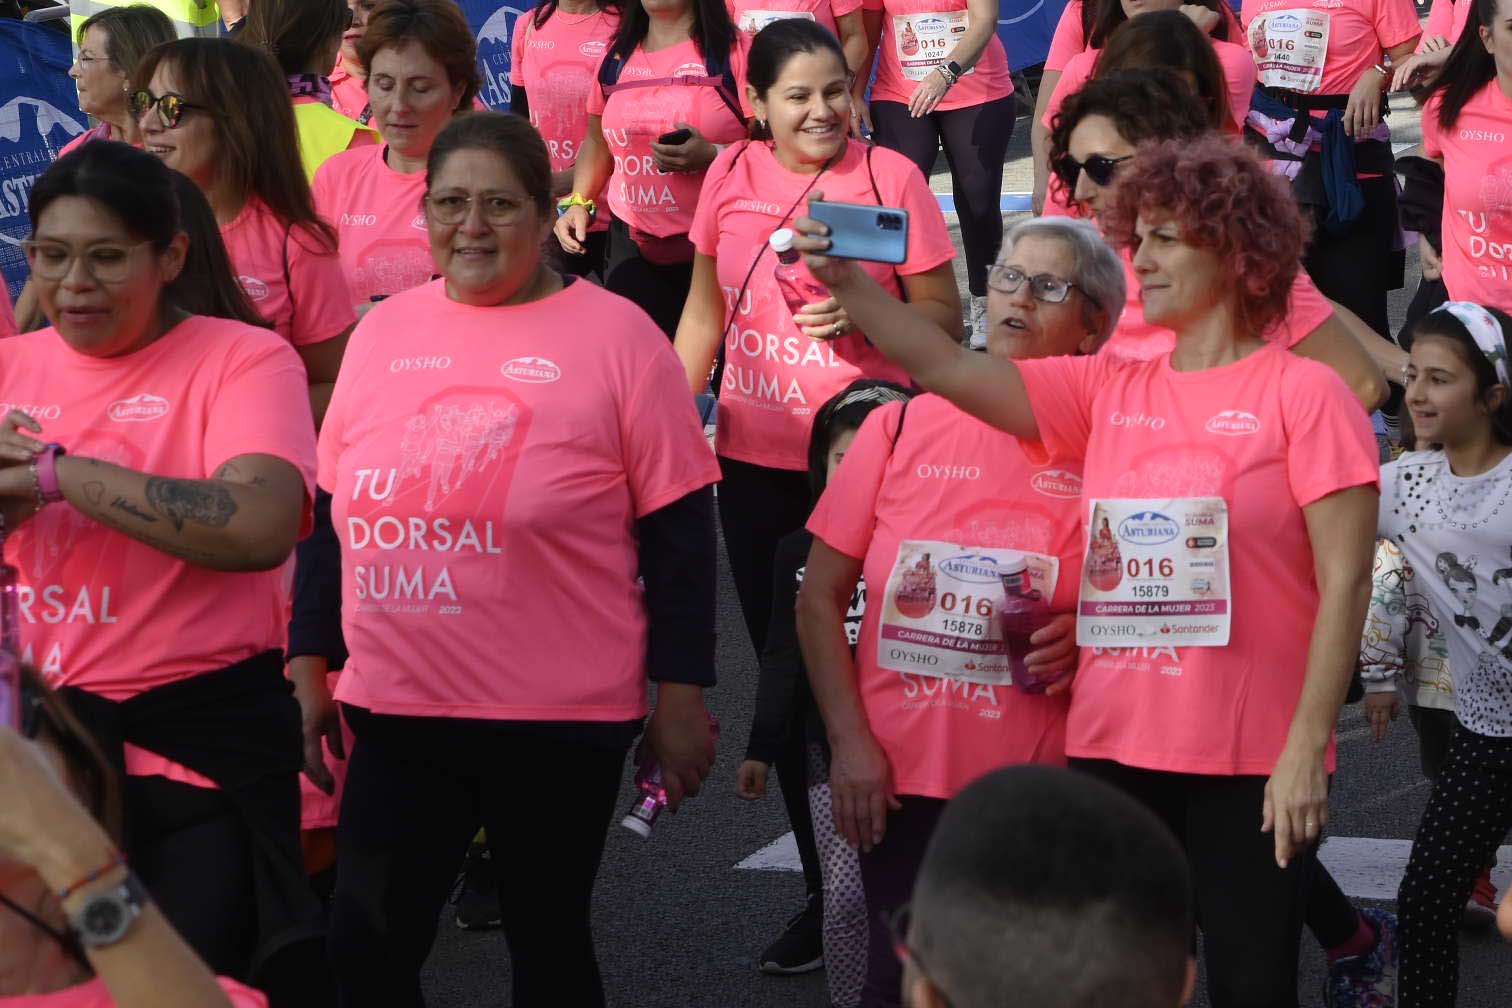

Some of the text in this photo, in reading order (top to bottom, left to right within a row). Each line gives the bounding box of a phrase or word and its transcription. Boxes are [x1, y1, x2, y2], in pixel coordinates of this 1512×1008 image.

[921, 38, 946, 50] 016
[1268, 38, 1295, 51] 016
[603, 128, 628, 147] TU
[1460, 129, 1505, 143] OYSHO
[620, 181, 676, 205] SUMA
[722, 286, 752, 315] TU
[730, 323, 841, 368] DORSAL
[390, 356, 451, 373] OYSHO
[725, 363, 810, 404] SUMA
[917, 464, 980, 481] OYSHO
[352, 468, 397, 501] TU
[1122, 524, 1176, 537] ASTURIANA
[1185, 517, 1216, 527] SUMA
[347, 516, 502, 554] DORSAL
[1126, 558, 1174, 578] 016
[355, 565, 458, 601] SUMA
[1131, 585, 1169, 598] 15879
[940, 591, 993, 617] 016
[1095, 604, 1133, 613] CARRERA
[1135, 603, 1147, 613] DE
[1148, 603, 1160, 612] LA
[1161, 603, 1191, 613] MUJER
[943, 618, 983, 637] 15878
[1090, 623, 1218, 636] OYSHO Santander
[898, 629, 970, 650] CARRERA DE LA
[890, 647, 938, 666] OYSHO
